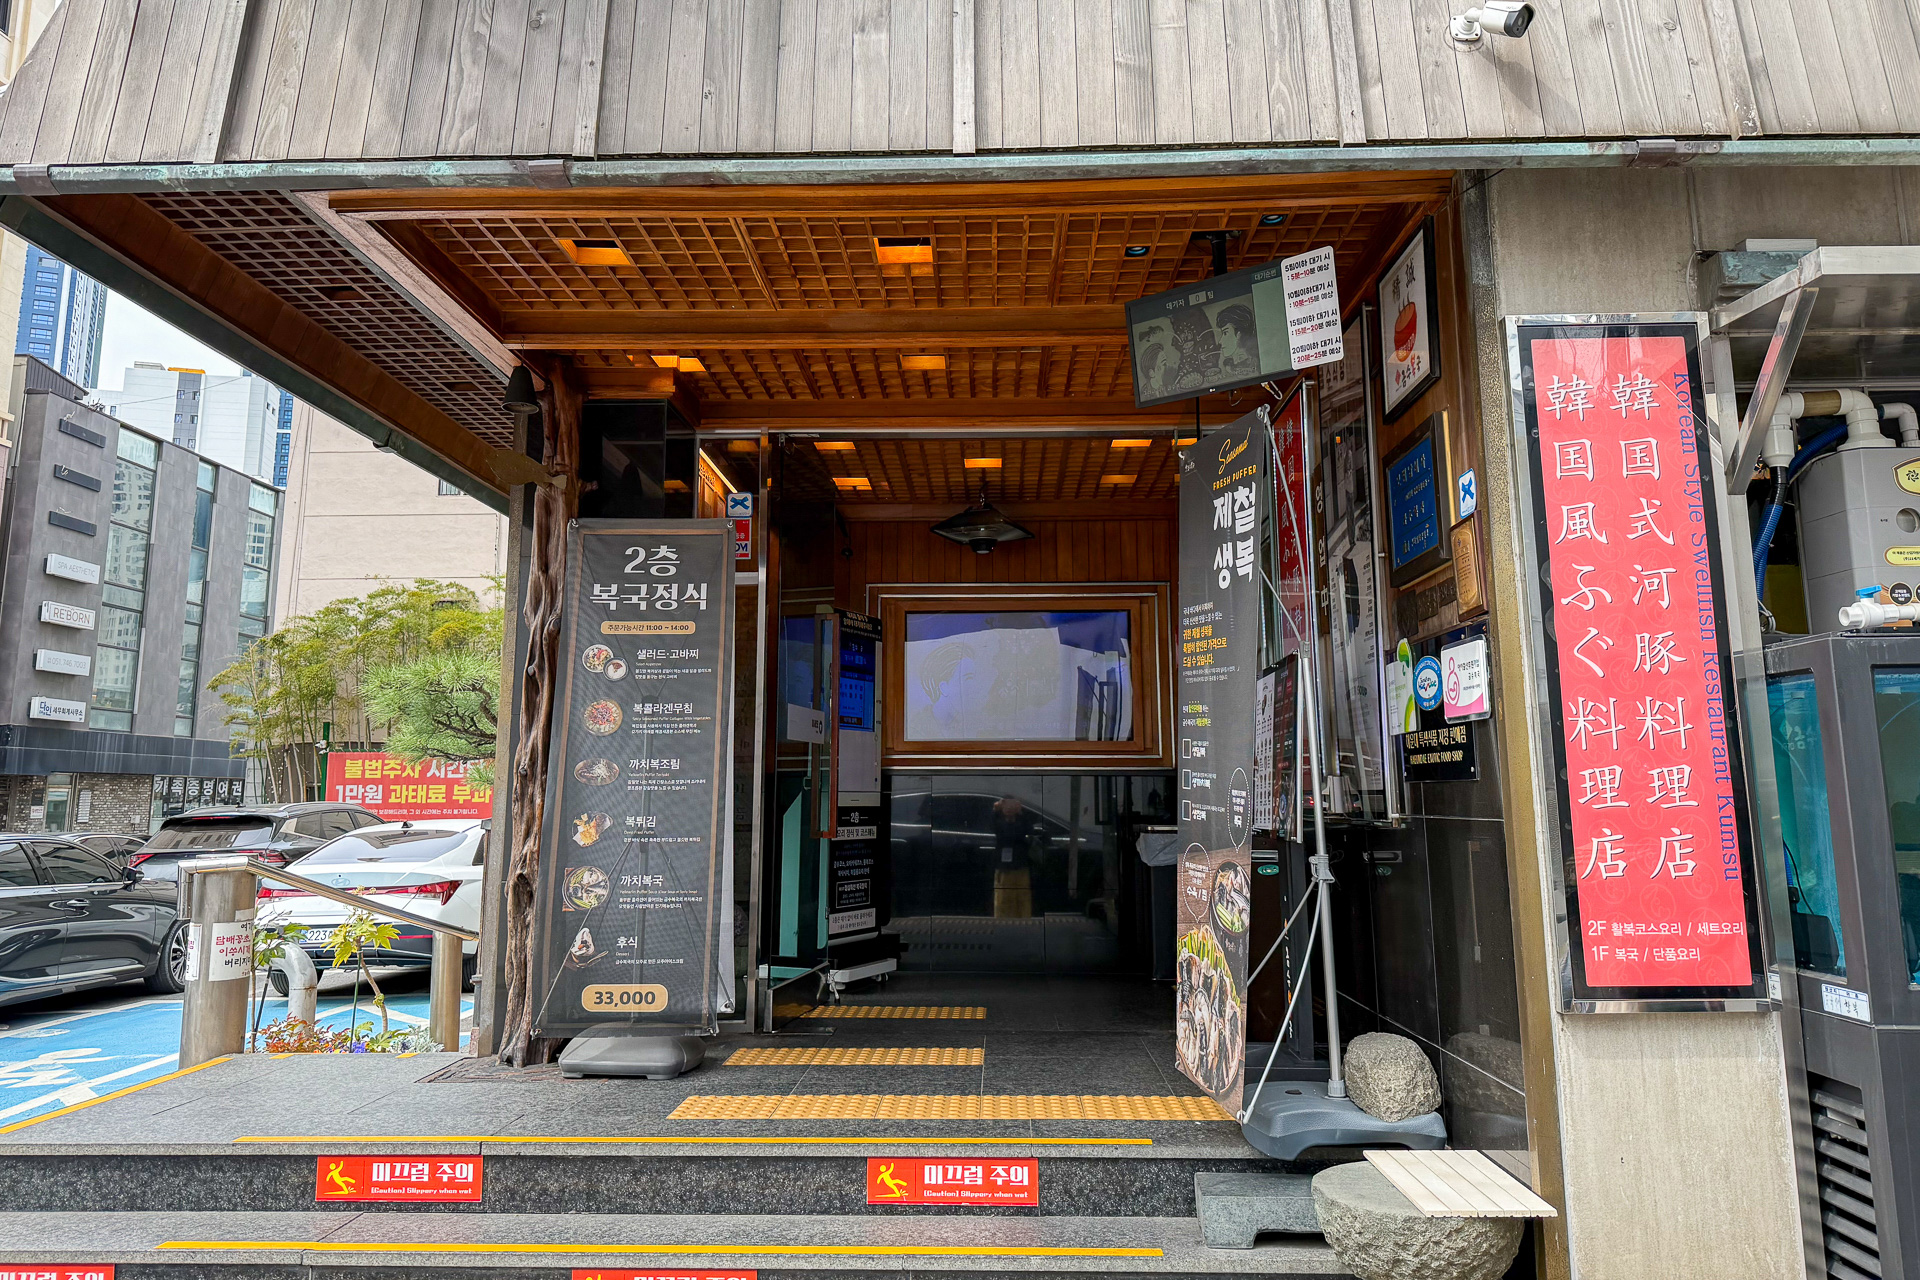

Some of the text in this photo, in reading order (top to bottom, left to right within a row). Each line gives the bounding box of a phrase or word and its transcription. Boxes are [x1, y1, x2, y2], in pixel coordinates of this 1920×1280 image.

[1309, 254, 1323, 265] 대기
[1317, 263, 1330, 273] 예상
[1166, 299, 1185, 310] 대기자
[1207, 291, 1214, 299] 팀
[1321, 290, 1334, 301] 예상
[1316, 310, 1330, 321] 대기
[1325, 318, 1338, 328] 예상
[1320, 338, 1334, 349] 대기
[1328, 346, 1342, 356] 예상
[1674, 372, 1698, 454] Korean
[1213, 464, 1257, 491] FRESH PUFFER
[1684, 463, 1704, 523] Style
[1213, 481, 1256, 535] 제철
[624, 545, 681, 577] 2층
[1213, 535, 1255, 590] 생복
[590, 582, 708, 611] 복국정식
[608, 624, 644, 632] 주문가능시간
[1544, 374, 1630, 880] 韓国風ふぐ料理店
[1609, 373, 1699, 880] 韓国式河豚料理店
[1208, 637, 1228, 650] 가격으로
[1703, 650, 1730, 784] Restaurant
[629, 758, 680, 770] 까치복조림
[1451, 750, 1464, 762] SHOP
[336, 784, 492, 804] 1만원 과태료 부과
[625, 816, 656, 828] 복튀김
[850, 812, 860, 824] 2층
[1716, 793, 1740, 882] Kumsu
[620, 875, 663, 887] 까치복국
[1588, 920, 1744, 936] 2F 활복코스요리 / 세트요리
[616, 936, 638, 949] 후식
[1592, 946, 1701, 962] 1F 복국 / 단품요리
[593, 991, 656, 1008] 33,000
[372, 1162, 474, 1183] 미끄럼 주의
[924, 1165, 1029, 1186] 미끄럼 주의
[407, 1186, 437, 1195] Slippery
[960, 1189, 991, 1198] Slippery
[1014, 1190, 1028, 1198] wet
